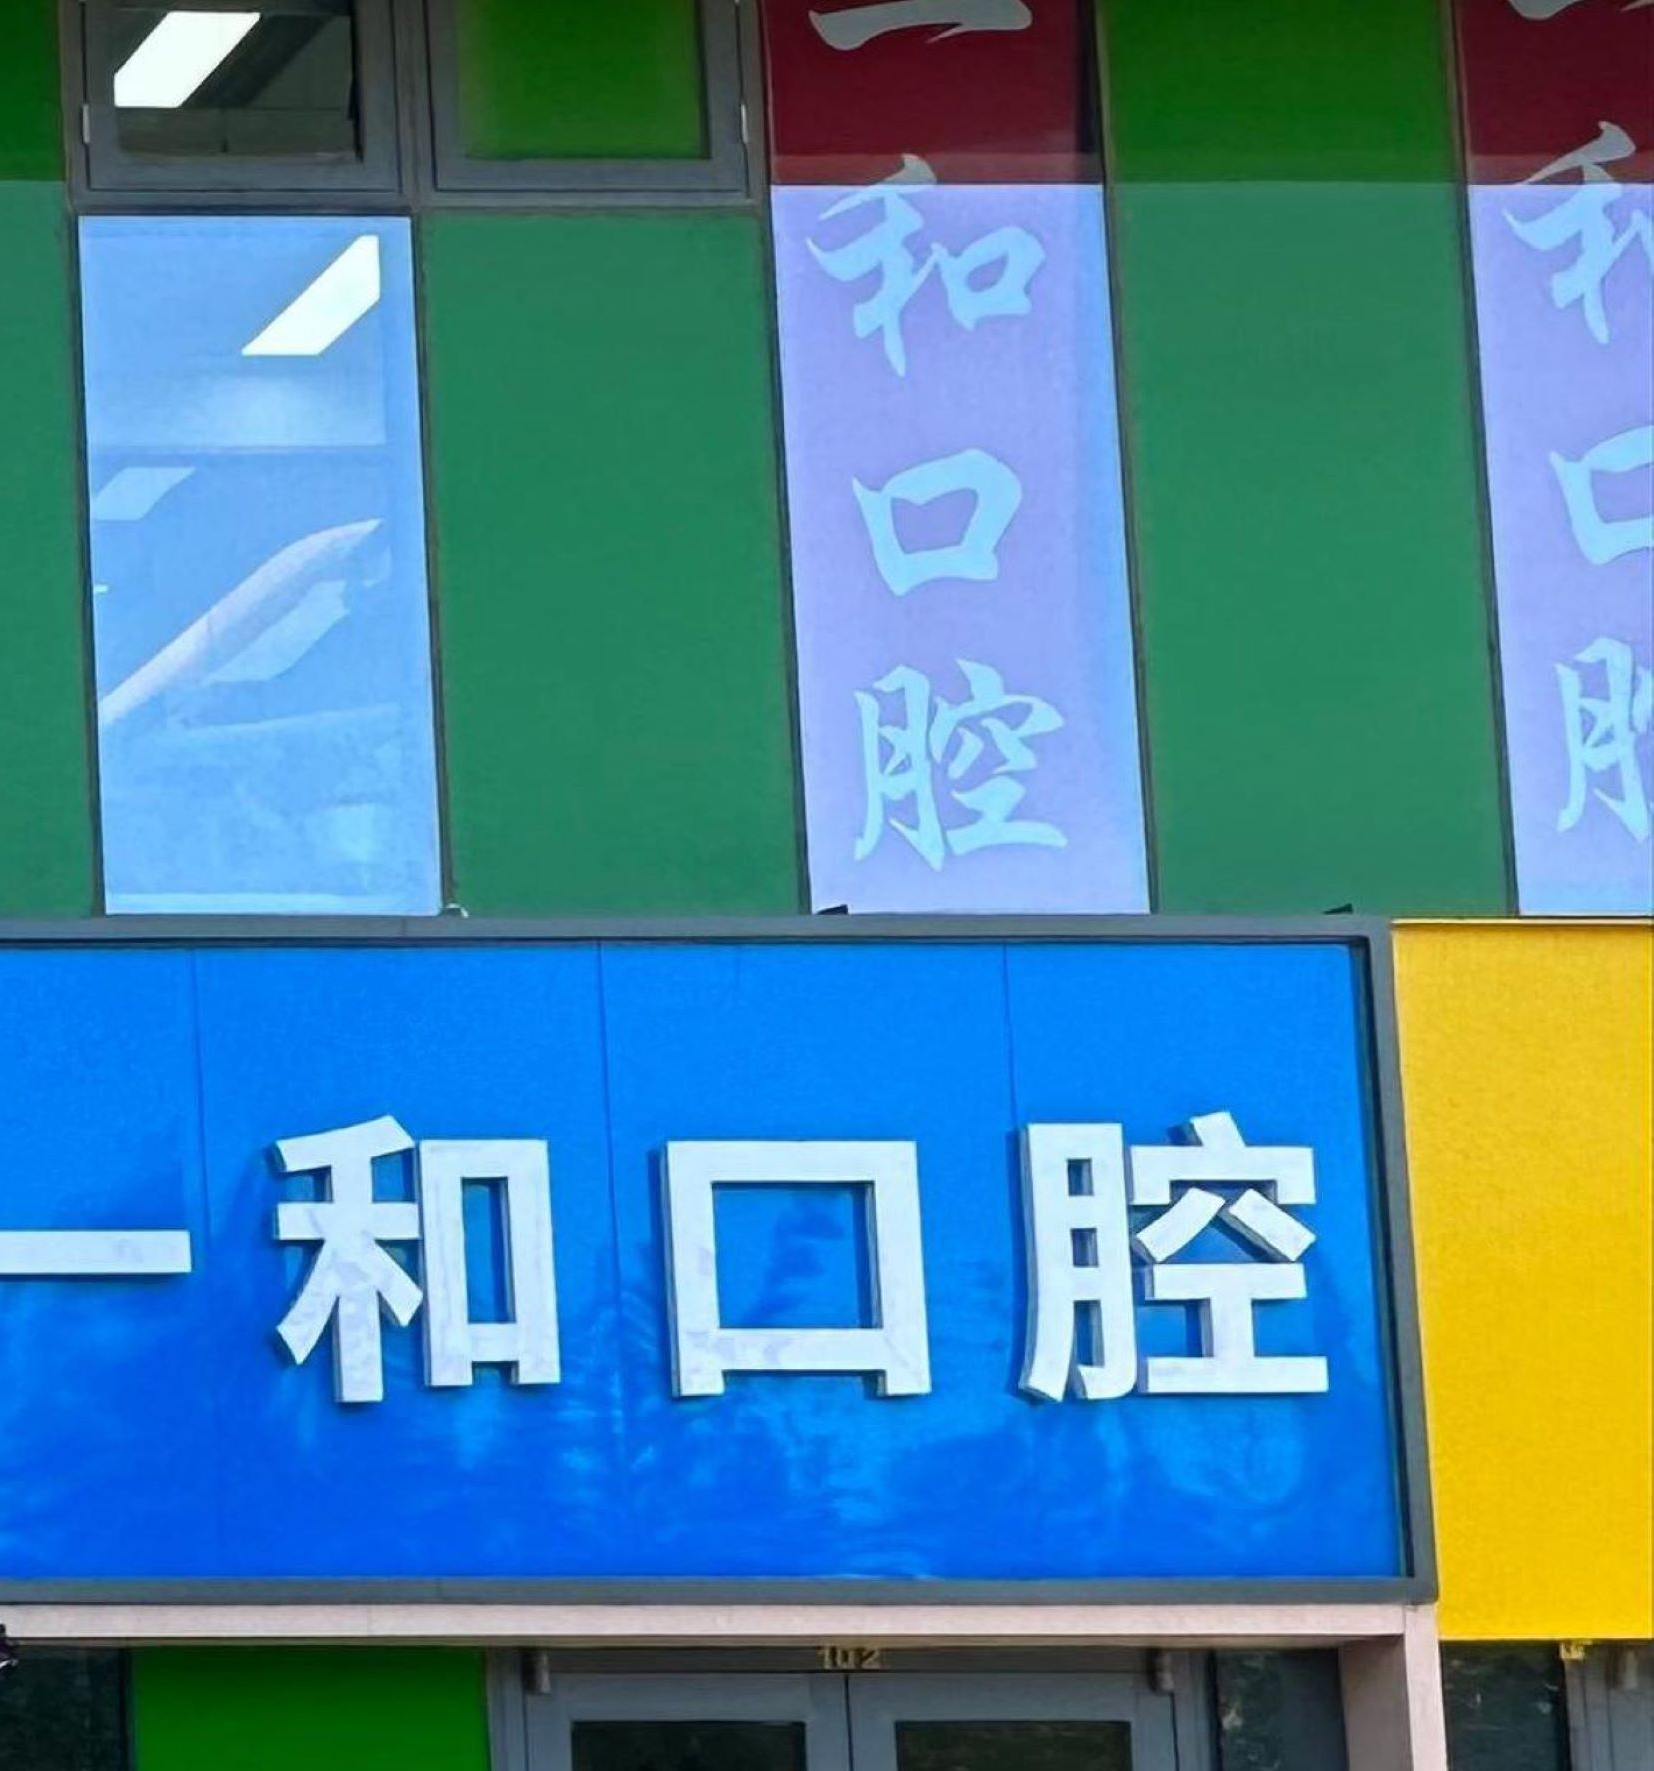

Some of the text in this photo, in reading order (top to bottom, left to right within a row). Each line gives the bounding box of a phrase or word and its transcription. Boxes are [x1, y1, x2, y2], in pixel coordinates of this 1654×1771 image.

[806, 0, 1067, 873] 一和口腔
[818, 1645, 882, 1668] 102
